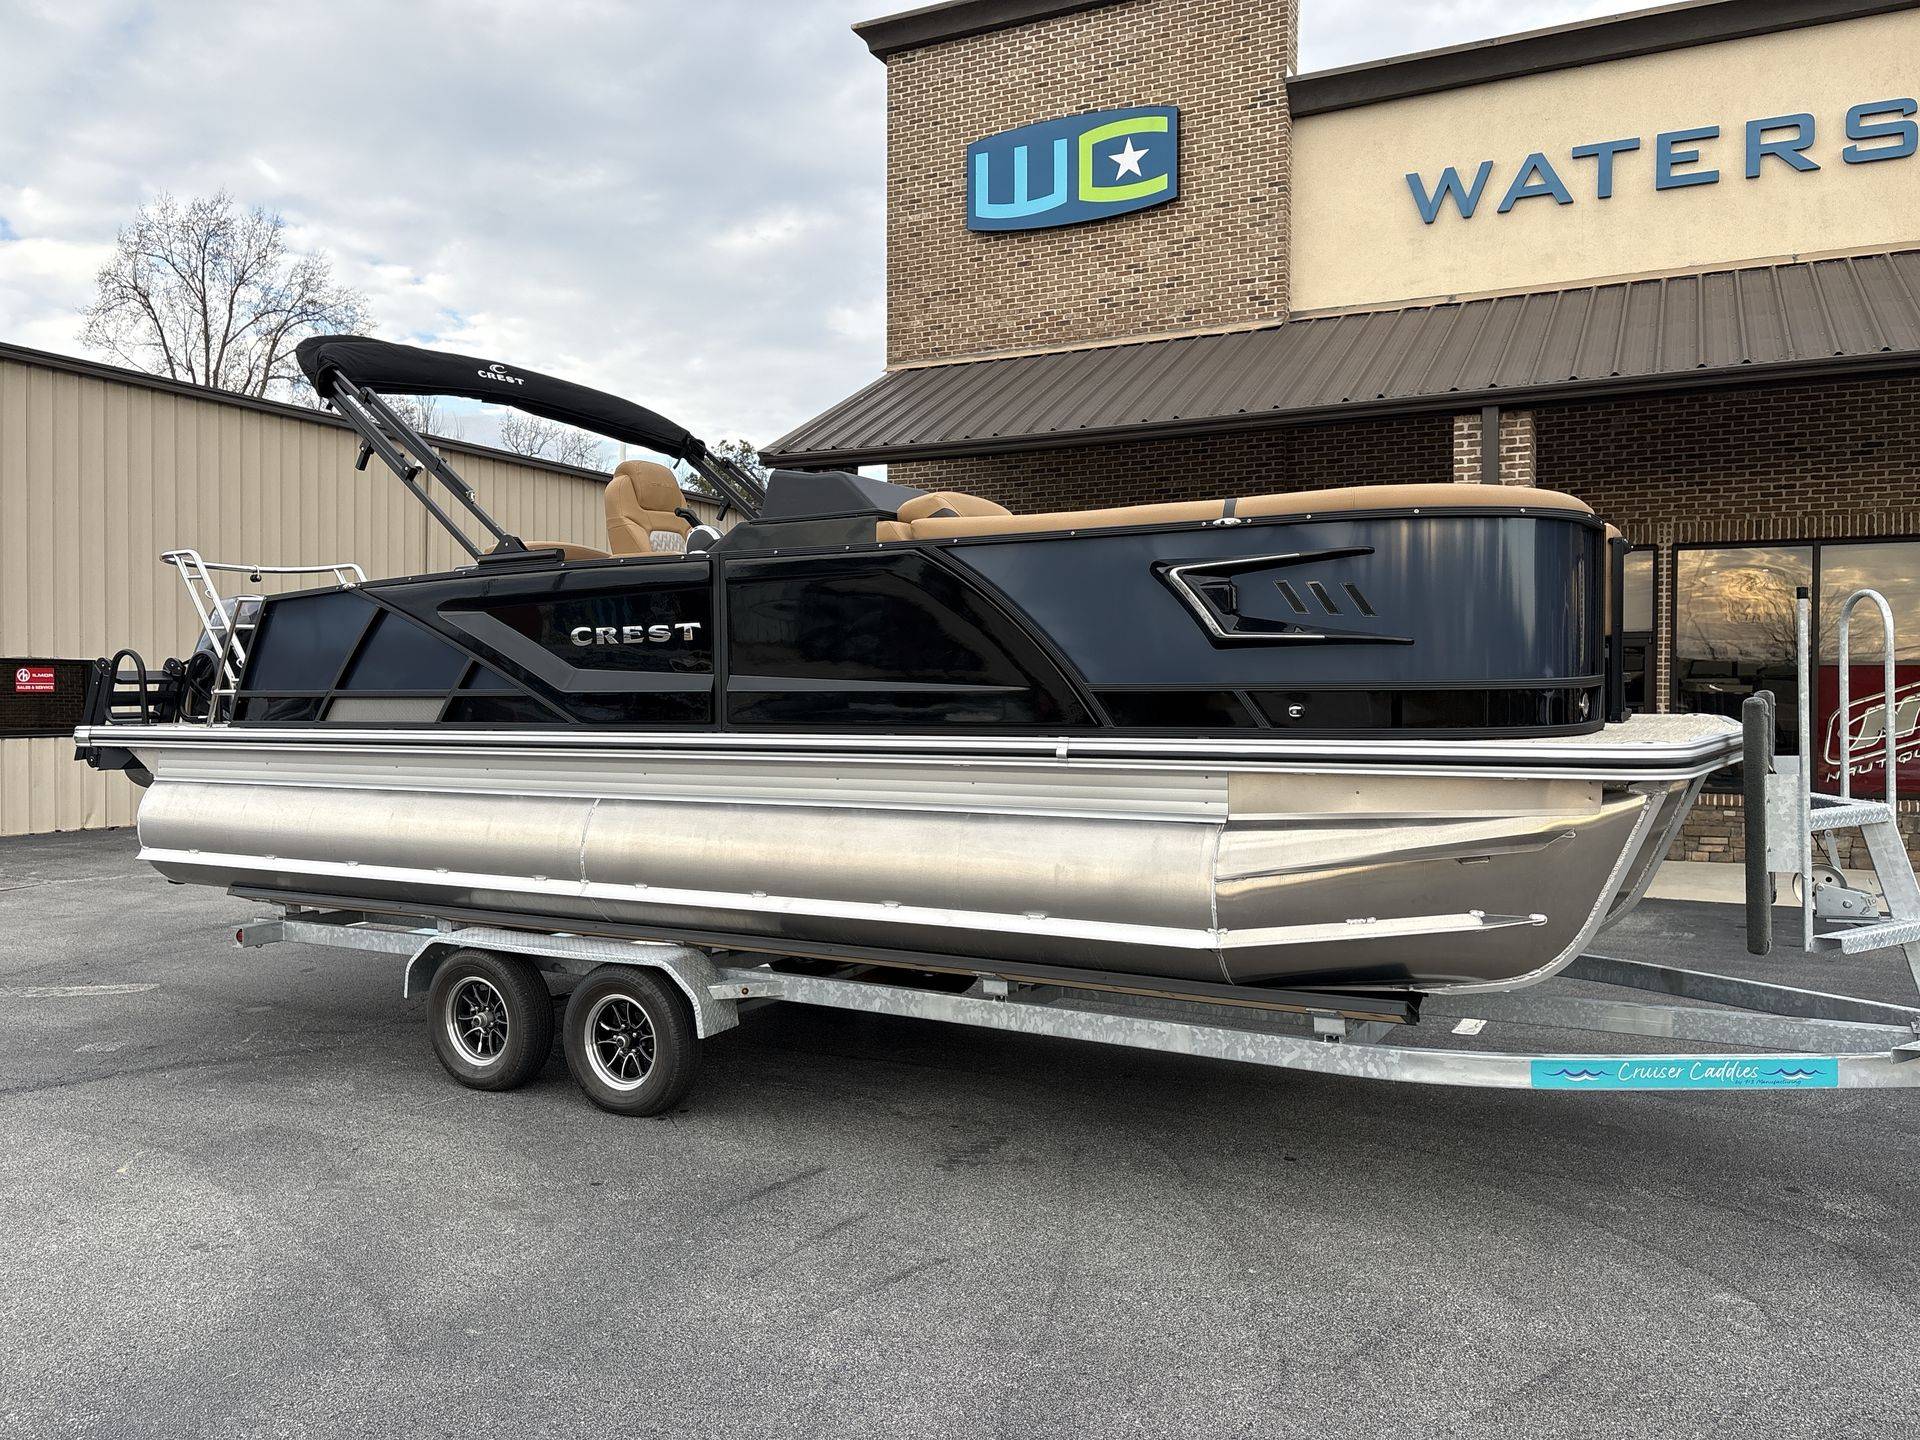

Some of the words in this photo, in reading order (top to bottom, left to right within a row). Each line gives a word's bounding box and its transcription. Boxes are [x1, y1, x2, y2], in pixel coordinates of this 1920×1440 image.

[1405, 97, 1919, 225] WATERS
[477, 369, 525, 385] CREST
[570, 622, 702, 647] CREST
[1618, 1062, 1685, 1081] Cruiser
[1689, 1061, 1760, 1082] Caddies
